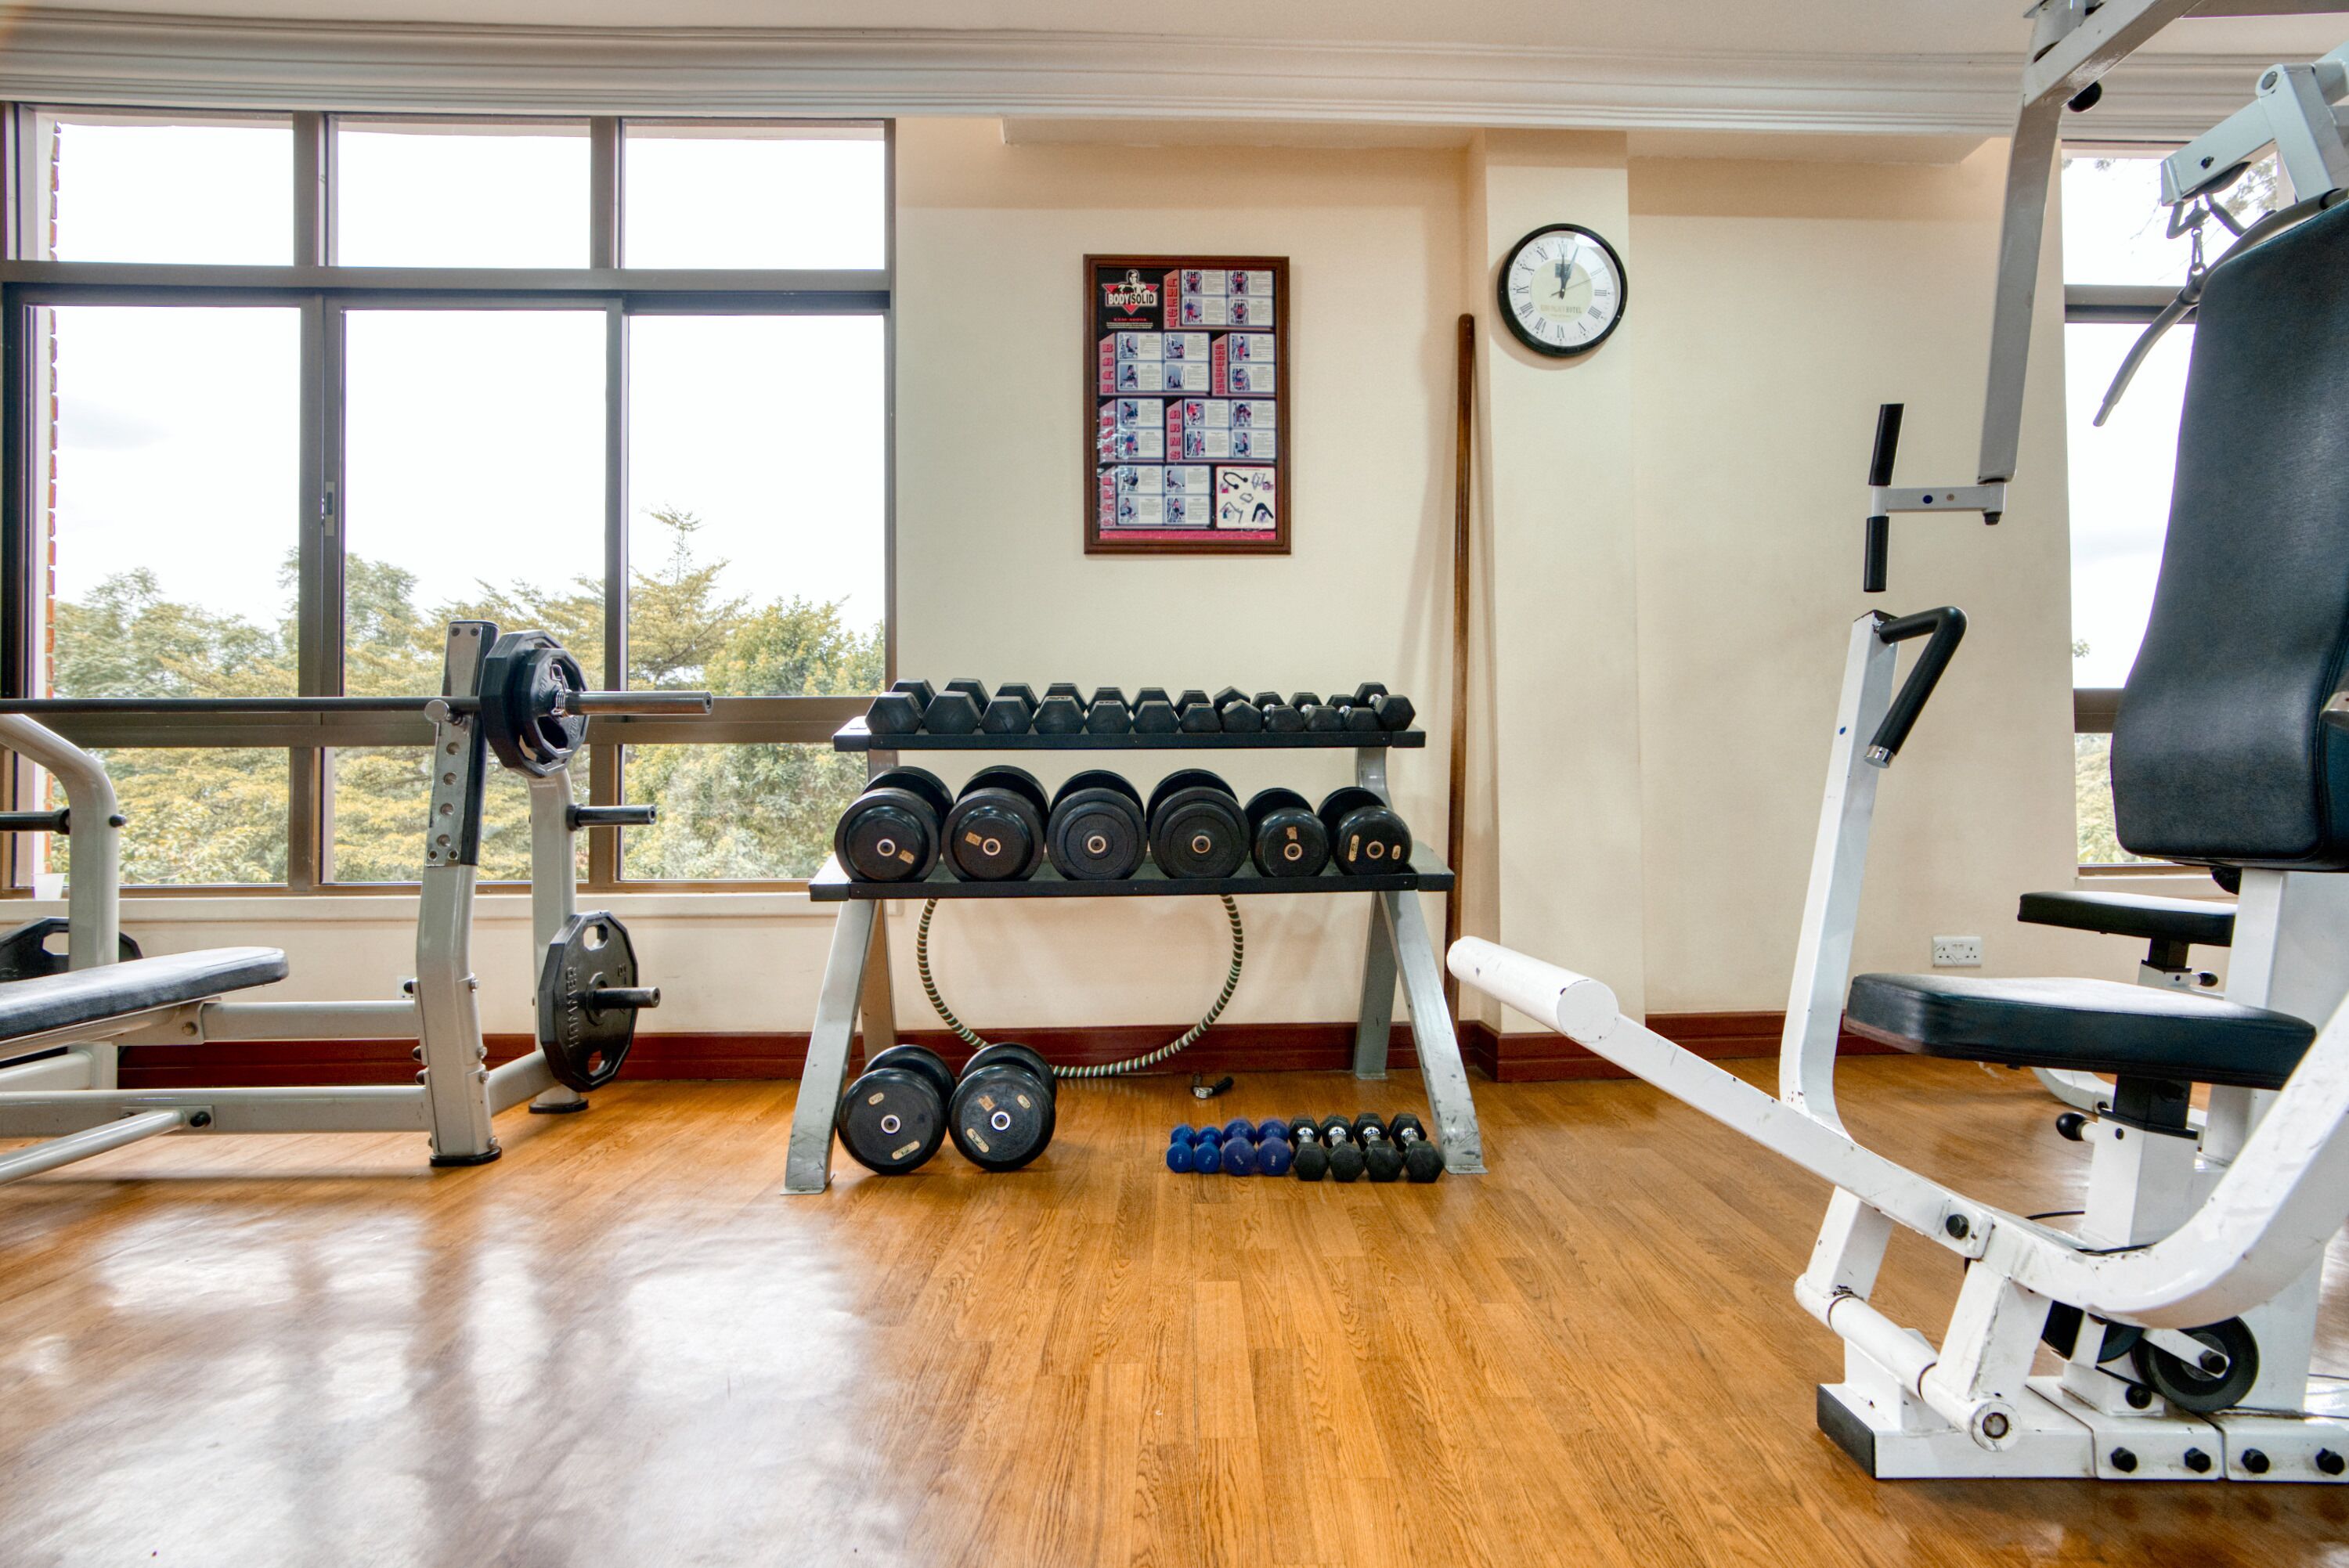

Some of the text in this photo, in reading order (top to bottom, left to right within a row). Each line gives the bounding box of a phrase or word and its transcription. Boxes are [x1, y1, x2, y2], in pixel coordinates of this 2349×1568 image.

[1108, 293, 1154, 305] BODY SOLID
[1102, 344, 1113, 393] BACK
[1169, 409, 1181, 460] ARMS
